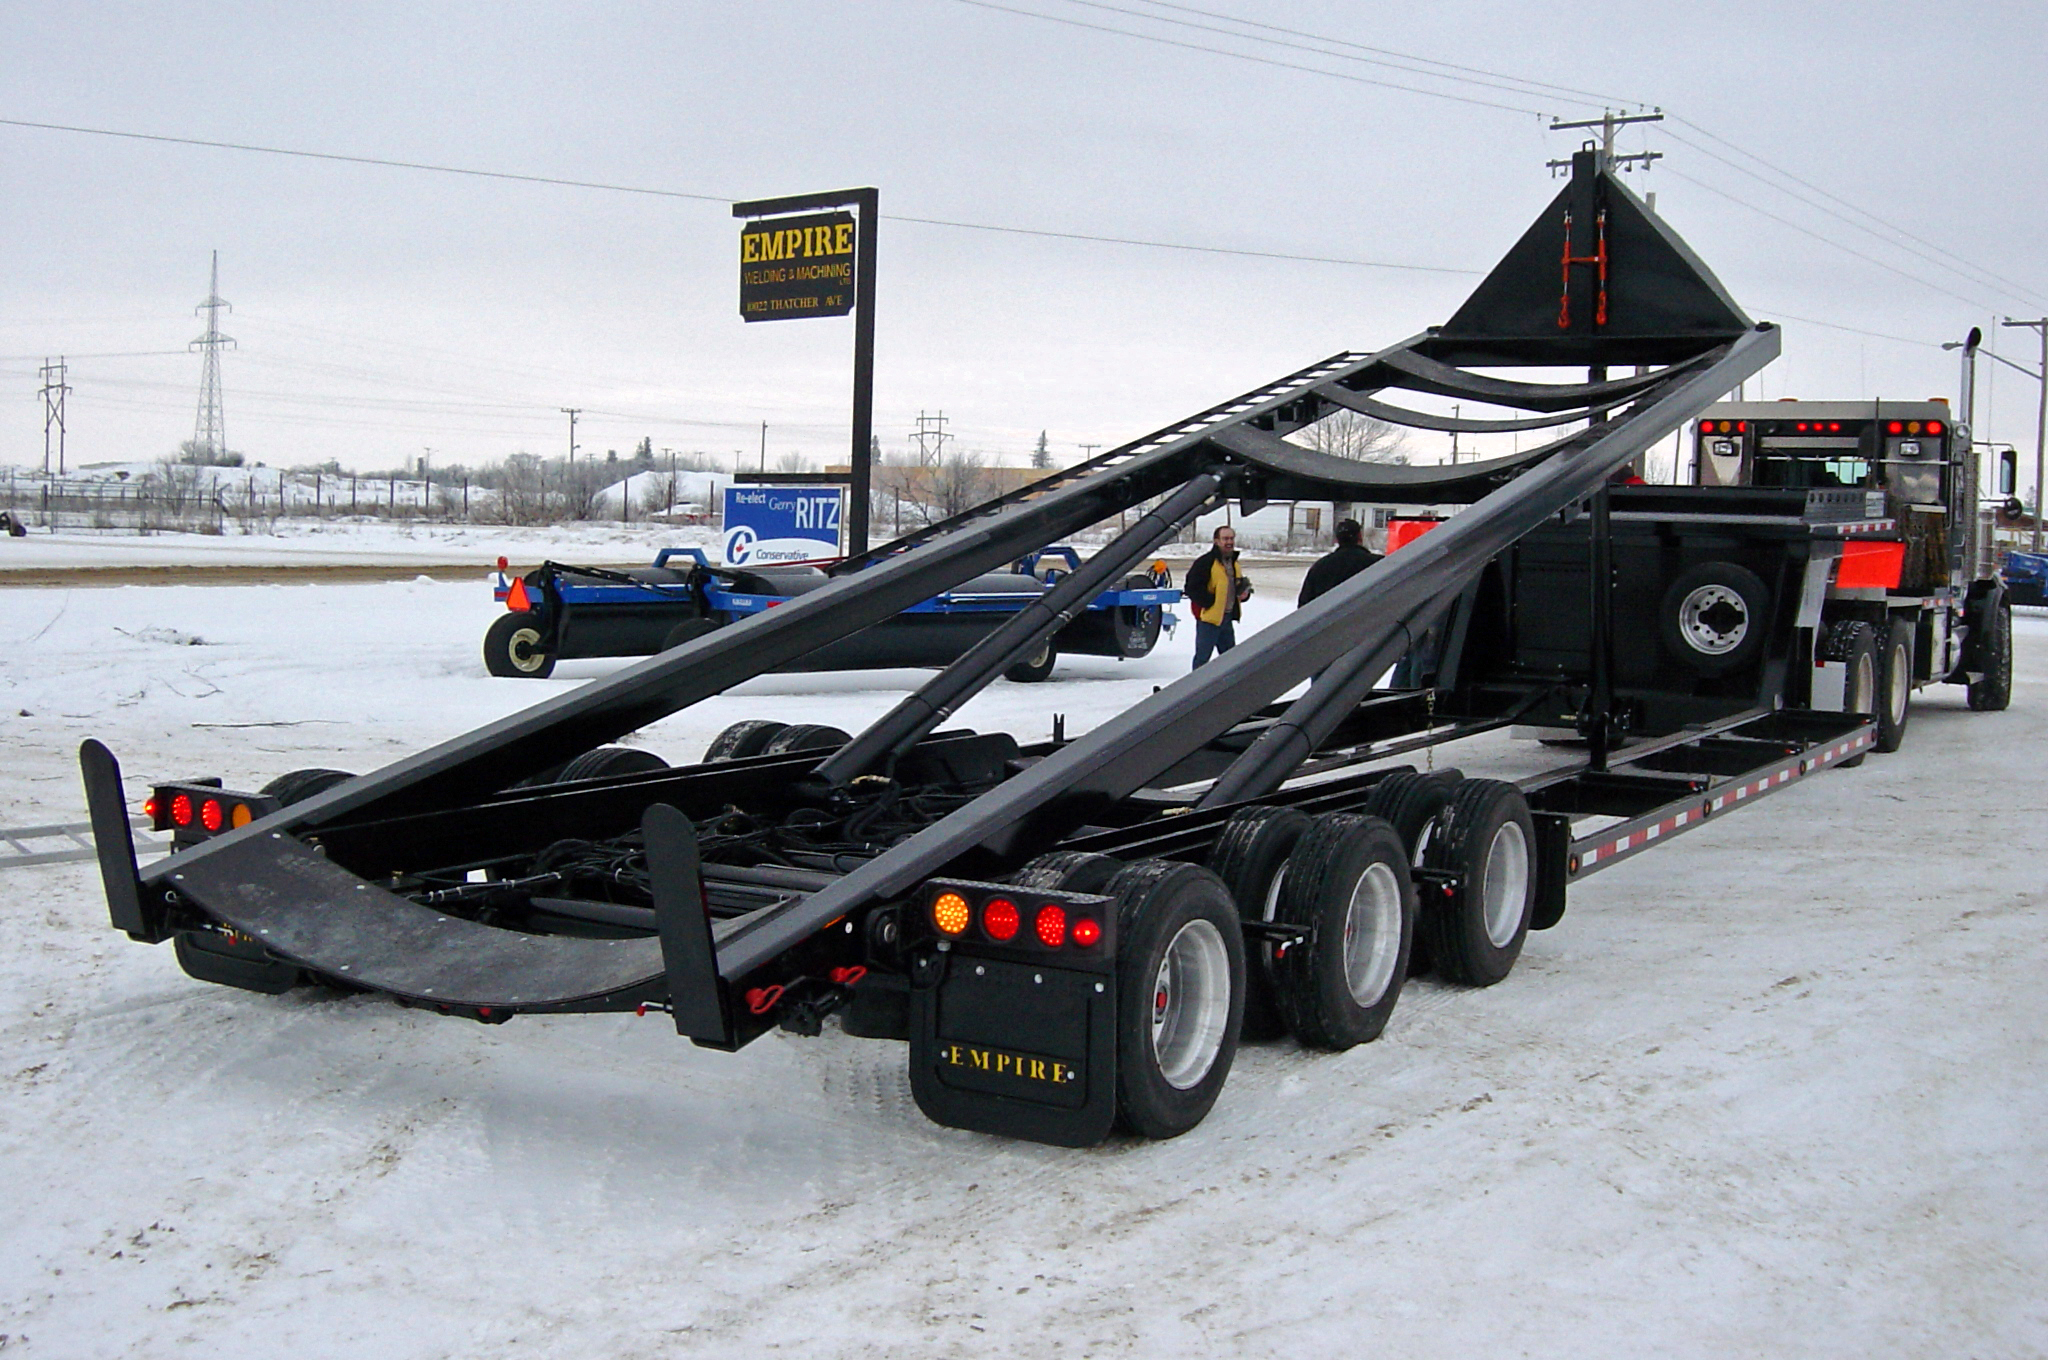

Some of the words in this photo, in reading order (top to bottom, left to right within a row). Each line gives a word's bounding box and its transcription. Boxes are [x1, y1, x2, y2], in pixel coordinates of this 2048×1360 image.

[743, 223, 853, 263] EMPIRE
[744, 268, 786, 285] WELDING
[796, 263, 851, 280] MACHINING
[771, 297, 819, 310] THATCHER
[735, 491, 766, 504] Re-elect
[768, 497, 797, 513] Gerry
[795, 497, 840, 529] RITZ
[756, 549, 809, 561] Conservative
[950, 1046, 1068, 1084] EMPIRE
